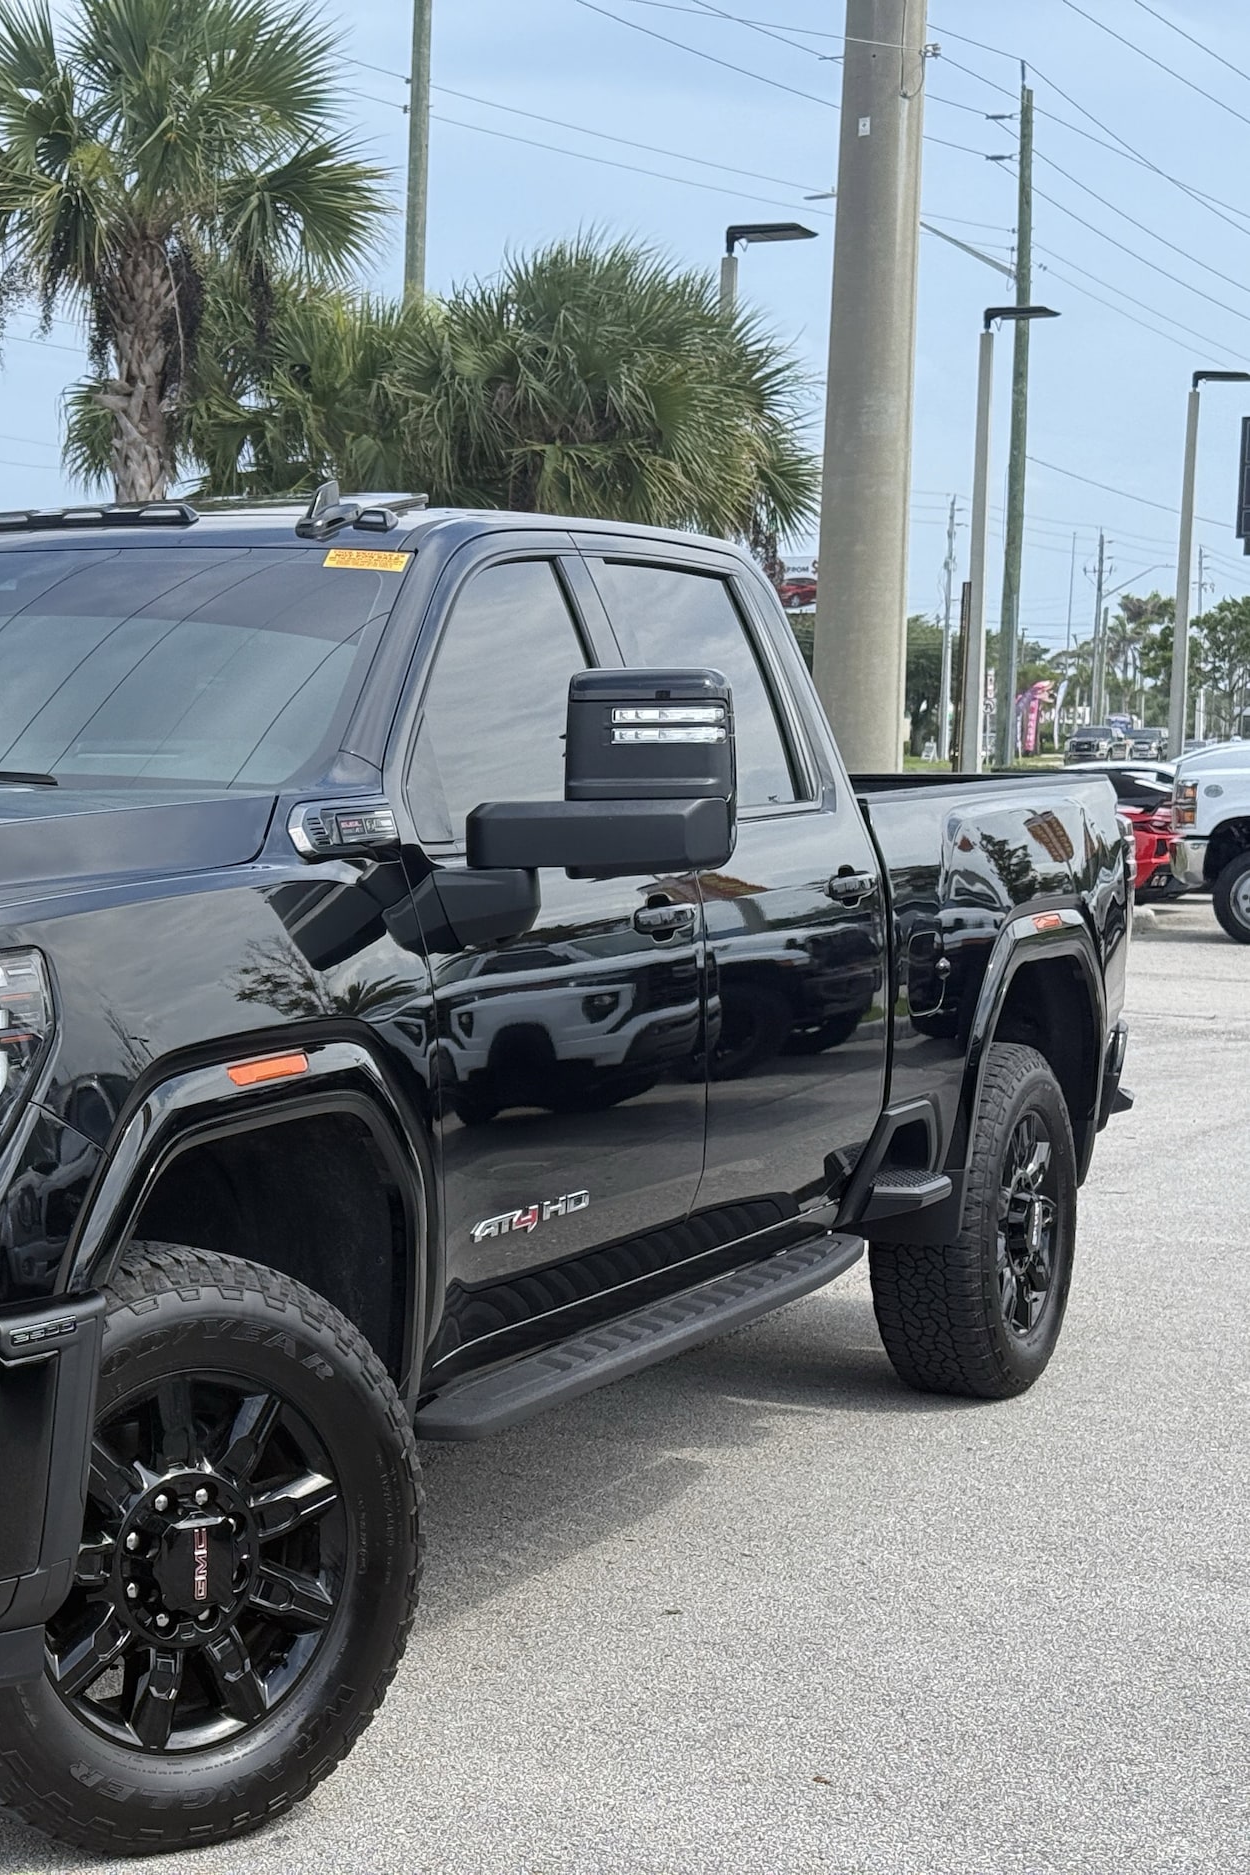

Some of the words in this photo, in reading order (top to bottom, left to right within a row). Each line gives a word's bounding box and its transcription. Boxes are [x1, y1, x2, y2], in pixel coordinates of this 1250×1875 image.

[470, 1204, 539, 1243] AT4
[543, 1190, 590, 1221] HD
[101, 1319, 335, 1381] ODYEAR
[194, 1528, 207, 1600] GMC
